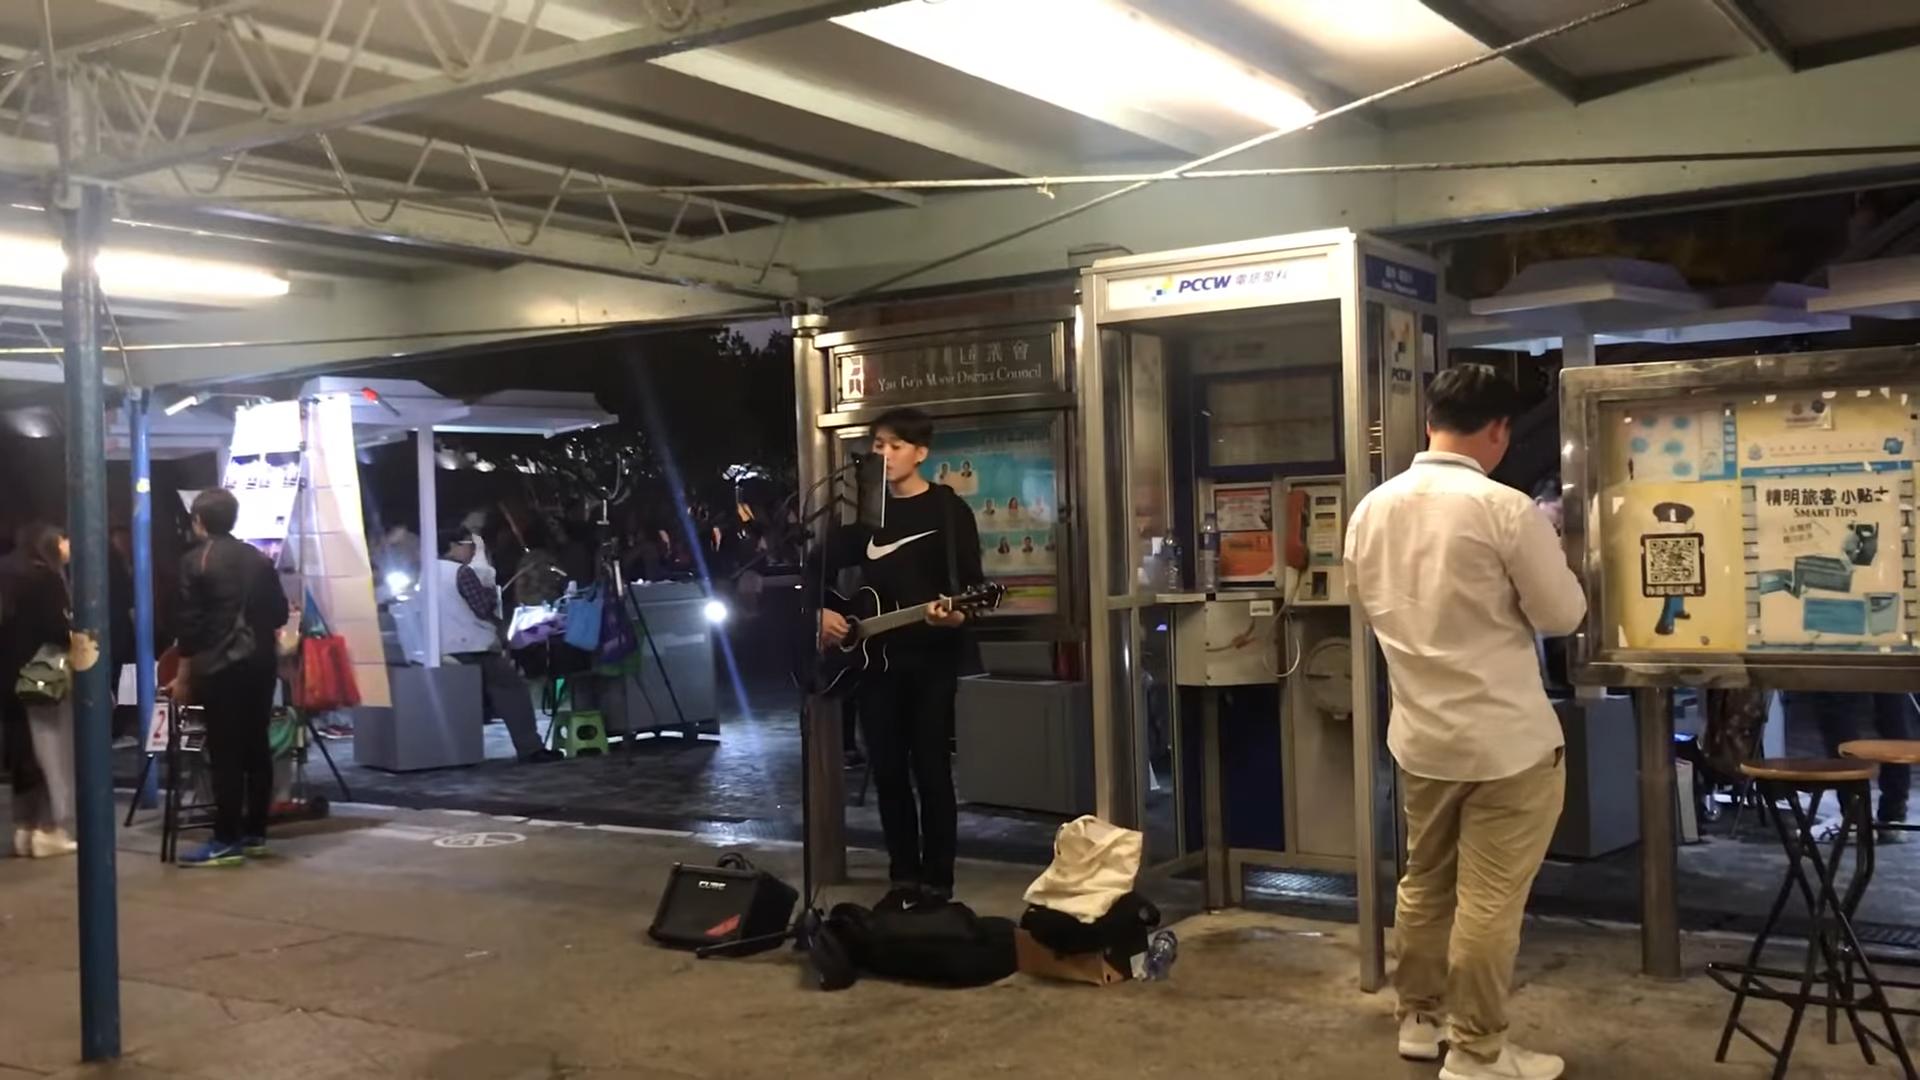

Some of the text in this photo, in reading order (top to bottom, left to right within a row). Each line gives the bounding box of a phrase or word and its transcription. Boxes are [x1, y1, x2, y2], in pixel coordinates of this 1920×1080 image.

[1178, 275, 1232, 293] PCCW
[996, 362, 1041, 381] Council
[1765, 488, 1837, 506] 精明旅客
[1793, 507, 1858, 518] SMART TIPS
